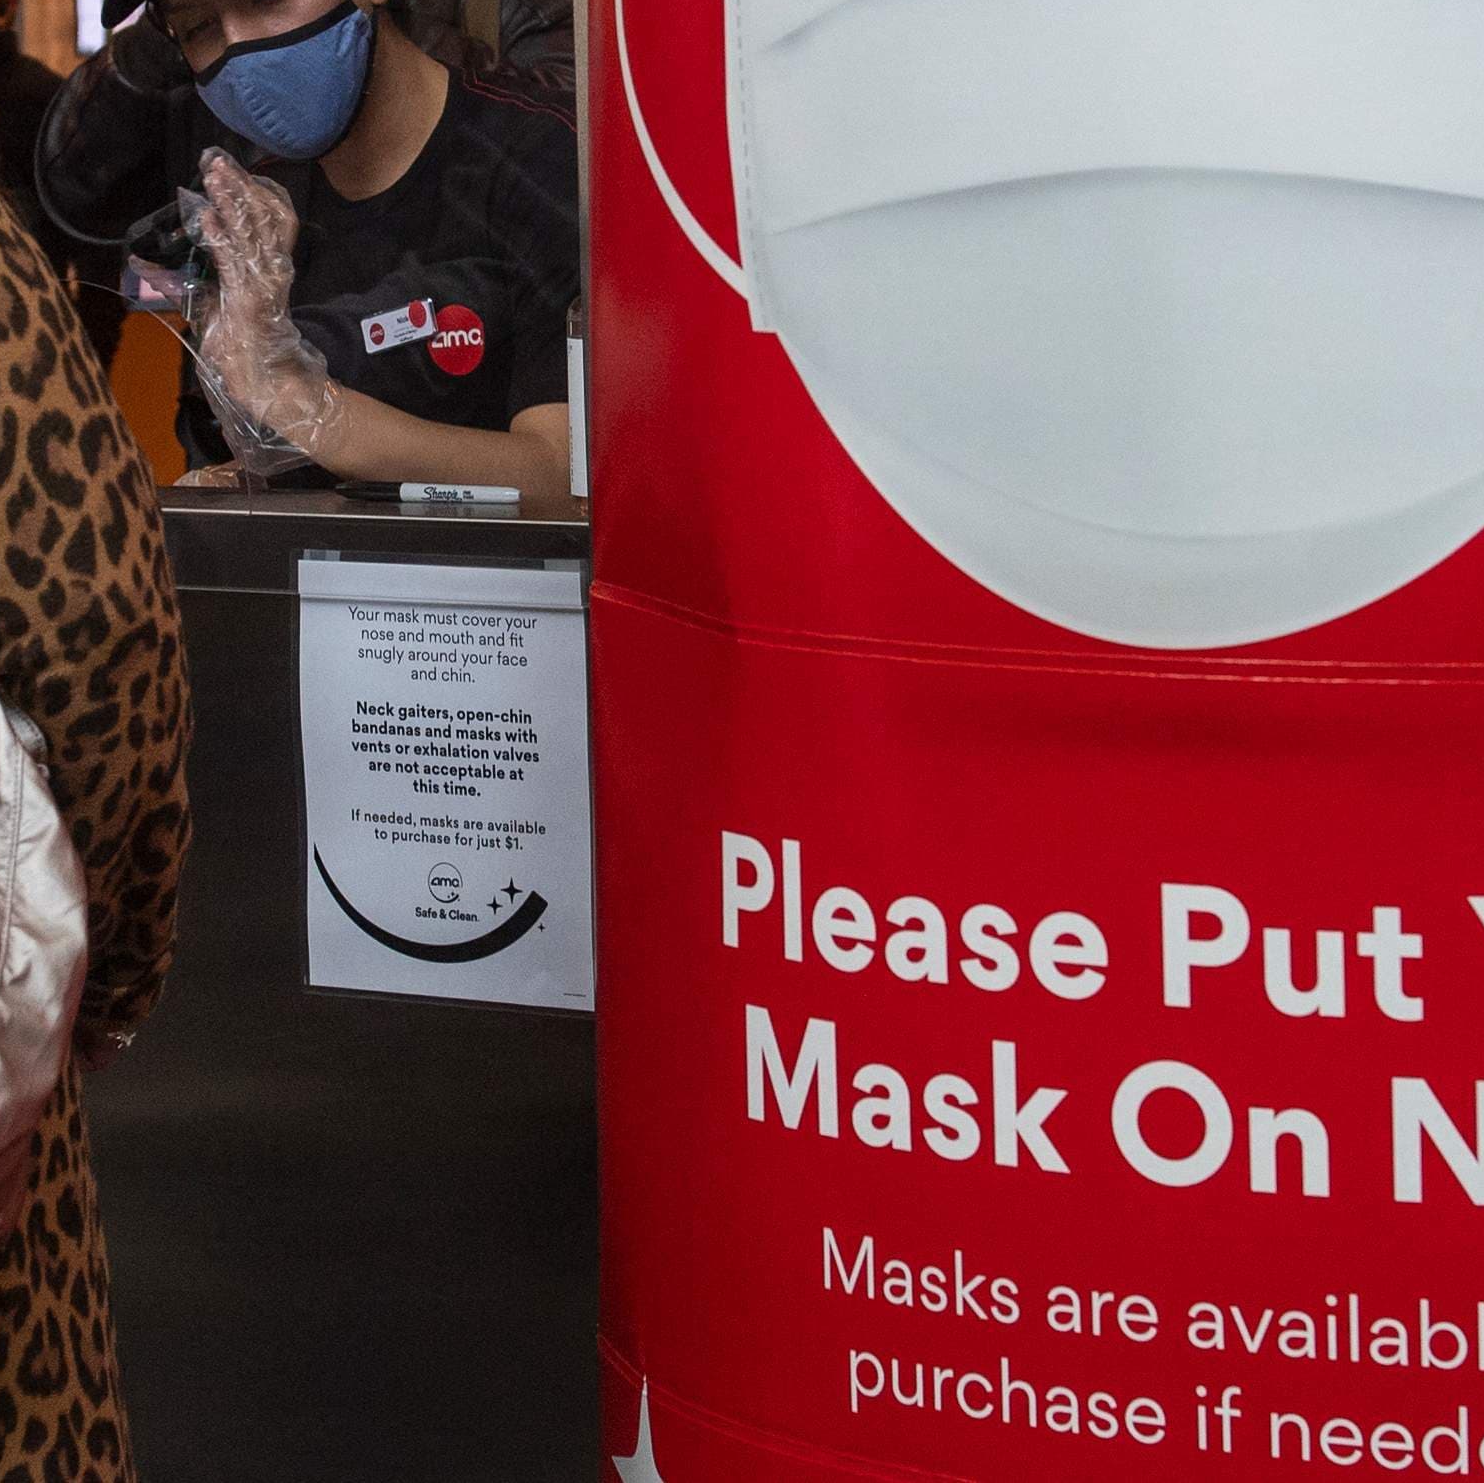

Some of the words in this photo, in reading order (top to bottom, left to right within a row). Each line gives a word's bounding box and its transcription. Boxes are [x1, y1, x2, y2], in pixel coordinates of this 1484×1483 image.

[348, 606, 380, 621] Your
[384, 609, 419, 624] mask
[423, 613, 457, 625] must
[462, 615, 502, 628] cover
[505, 617, 537, 632] your
[362, 629, 394, 641] nose
[399, 629, 424, 642] and
[429, 632, 474, 645] mouth
[479, 633, 505, 646] and
[510, 634, 523, 647] fit
[358, 647, 404, 664] snugly
[408, 649, 457, 663] around
[461, 654, 493, 667] your
[497, 652, 527, 666] face
[411, 667, 436, 680] and
[441, 669, 475, 682] chin.
[356, 701, 394, 716] Neck
[398, 704, 453, 722] gaiters,
[457, 709, 532, 724] open-chin
[352, 719, 420, 736] bandanas
[425, 724, 451, 738] and
[456, 726, 500, 741] masks
[505, 728, 537, 743] with
[351, 741, 391, 753] vents
[395, 744, 410, 754] or
[414, 743, 489, 759] exhalation
[493, 747, 539, 762] valves
[369, 761, 391, 772] are
[395, 761, 420, 773] not
[423, 764, 505, 780] acceptable
[509, 768, 524, 781] at
[413, 779, 439, 793] this
[444, 781, 481, 796] time.
[351, 809, 360, 821] If
[365, 811, 416, 827] needed,
[420, 815, 459, 828] masks
[464, 819, 483, 830] are
[488, 820, 546, 834] available
[374, 828, 387, 839] to
[392, 830, 450, 844] purchase
[455, 833, 473, 845] for
[477, 835, 500, 850] just
[505, 836, 523, 850] $1.
[431, 877, 459, 887] amc
[415, 907, 437, 918] Safe
[439, 909, 447, 919] &
[722, 831, 1108, 999] Please
[1161, 883, 1423, 1021] Put
[746, 1004, 1070, 1173] Mask
[1112, 1061, 1329, 1197] On
[824, 1228, 1019, 1323] Masks
[1047, 1286, 1158, 1341] are
[850, 1350, 1165, 1444] purchase
[1196, 1386, 1241, 1452] if
